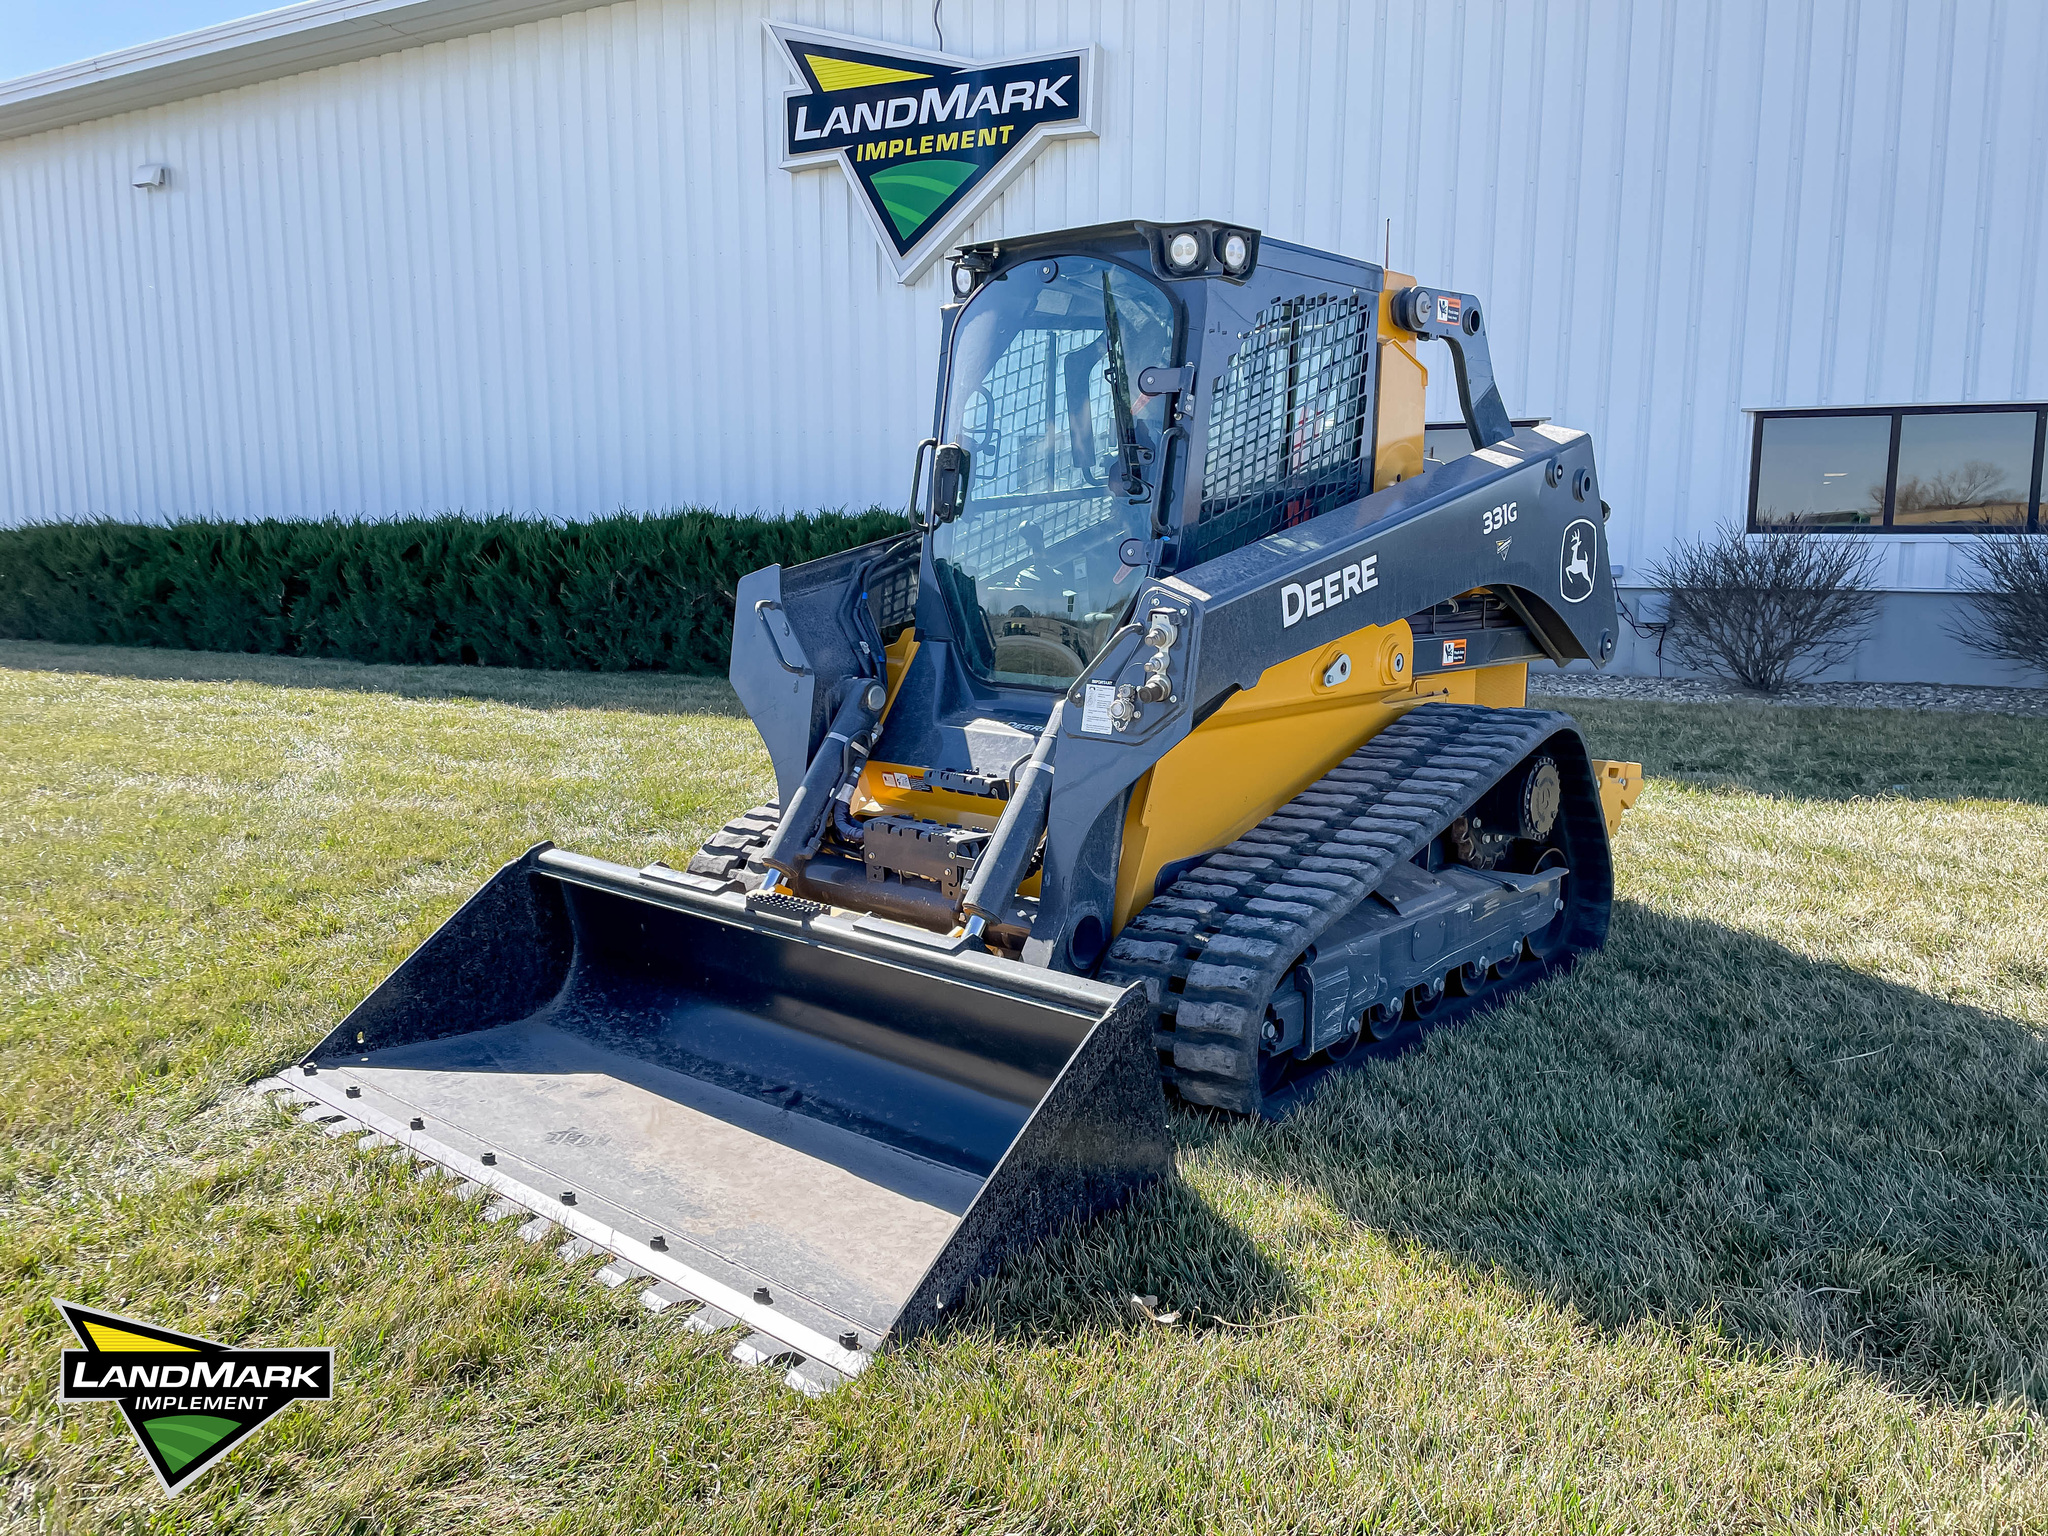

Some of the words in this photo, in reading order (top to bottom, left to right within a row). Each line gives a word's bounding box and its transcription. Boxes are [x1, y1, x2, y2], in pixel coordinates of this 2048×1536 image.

[856, 125, 1014, 162] IMPLEMENT
[1482, 501, 1518, 535] 331G
[1281, 554, 1378, 628] DEERE
